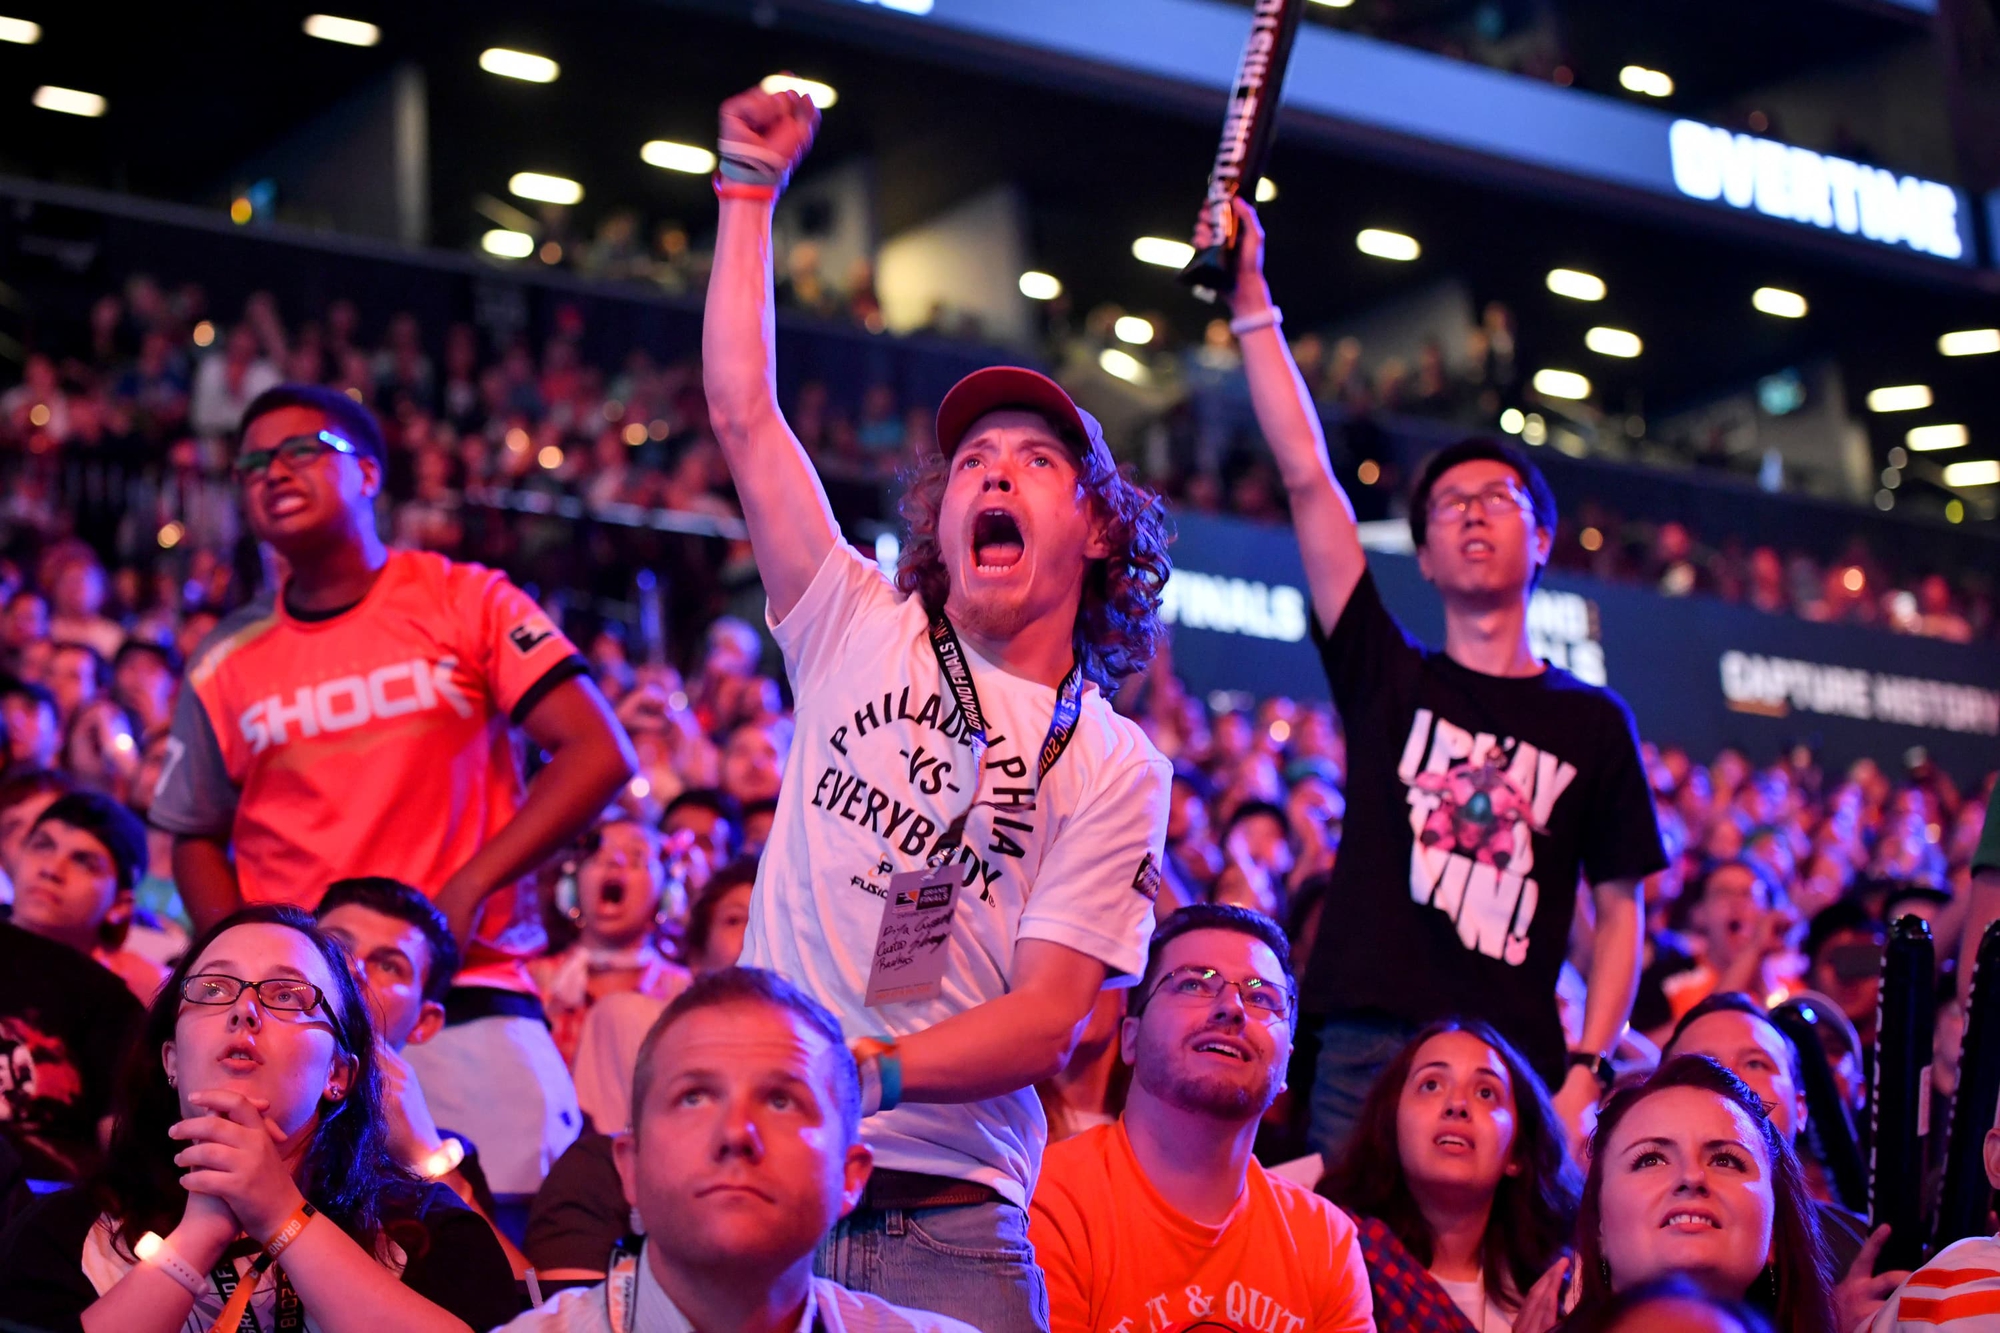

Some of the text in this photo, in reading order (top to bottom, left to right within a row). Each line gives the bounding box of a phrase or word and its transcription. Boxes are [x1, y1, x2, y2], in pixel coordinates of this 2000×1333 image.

[1669, 118, 1962, 260] OVERTIME
[1158, 568, 1307, 643] FINALS
[939, 641, 970, 686] FINALS
[1720, 650, 1872, 721] CAPTURE
[239, 654, 474, 755] SHOCK
[955, 686, 983, 731] GRAND
[850, 875, 889, 900] FUSIO
[267, 1219, 302, 1256] GRAND
[280, 1288, 298, 1329] 2018
[1184, 1284, 1214, 1318] &
[1225, 1280, 1306, 1333] QUIT
